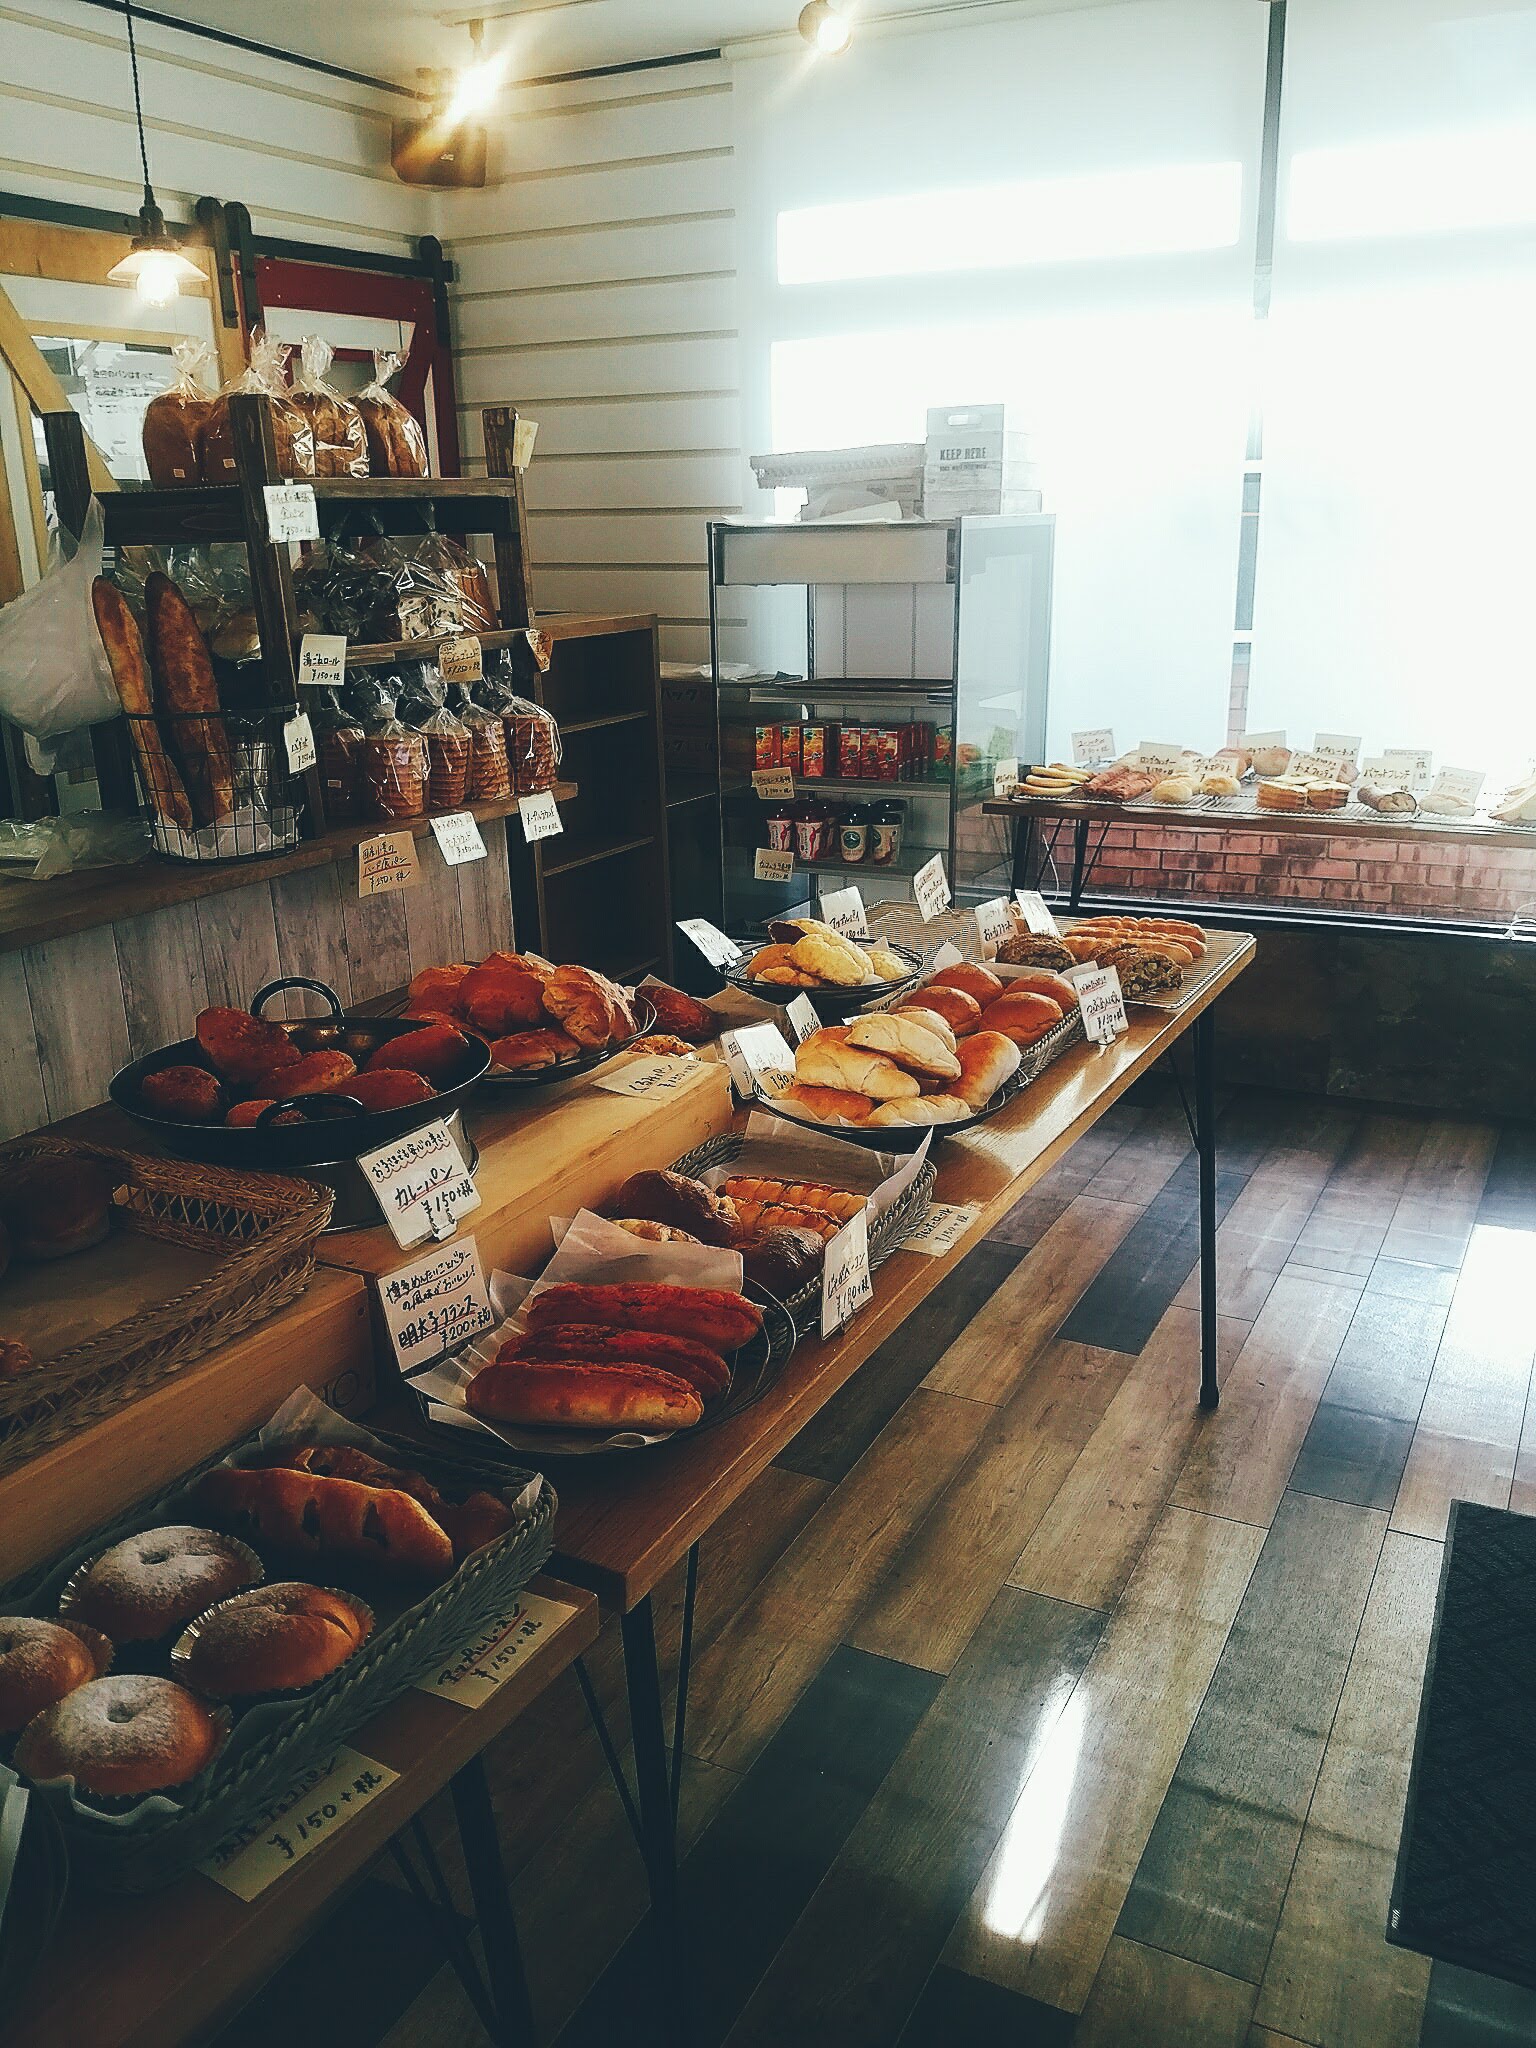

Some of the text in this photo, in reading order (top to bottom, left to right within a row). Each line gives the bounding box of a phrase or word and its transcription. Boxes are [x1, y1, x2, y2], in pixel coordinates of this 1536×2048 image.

[940, 447, 987, 461] KEEP HERE
[394, 1166, 453, 1207] カレーパン
[398, 1294, 479, 1350] 明太子フランス
